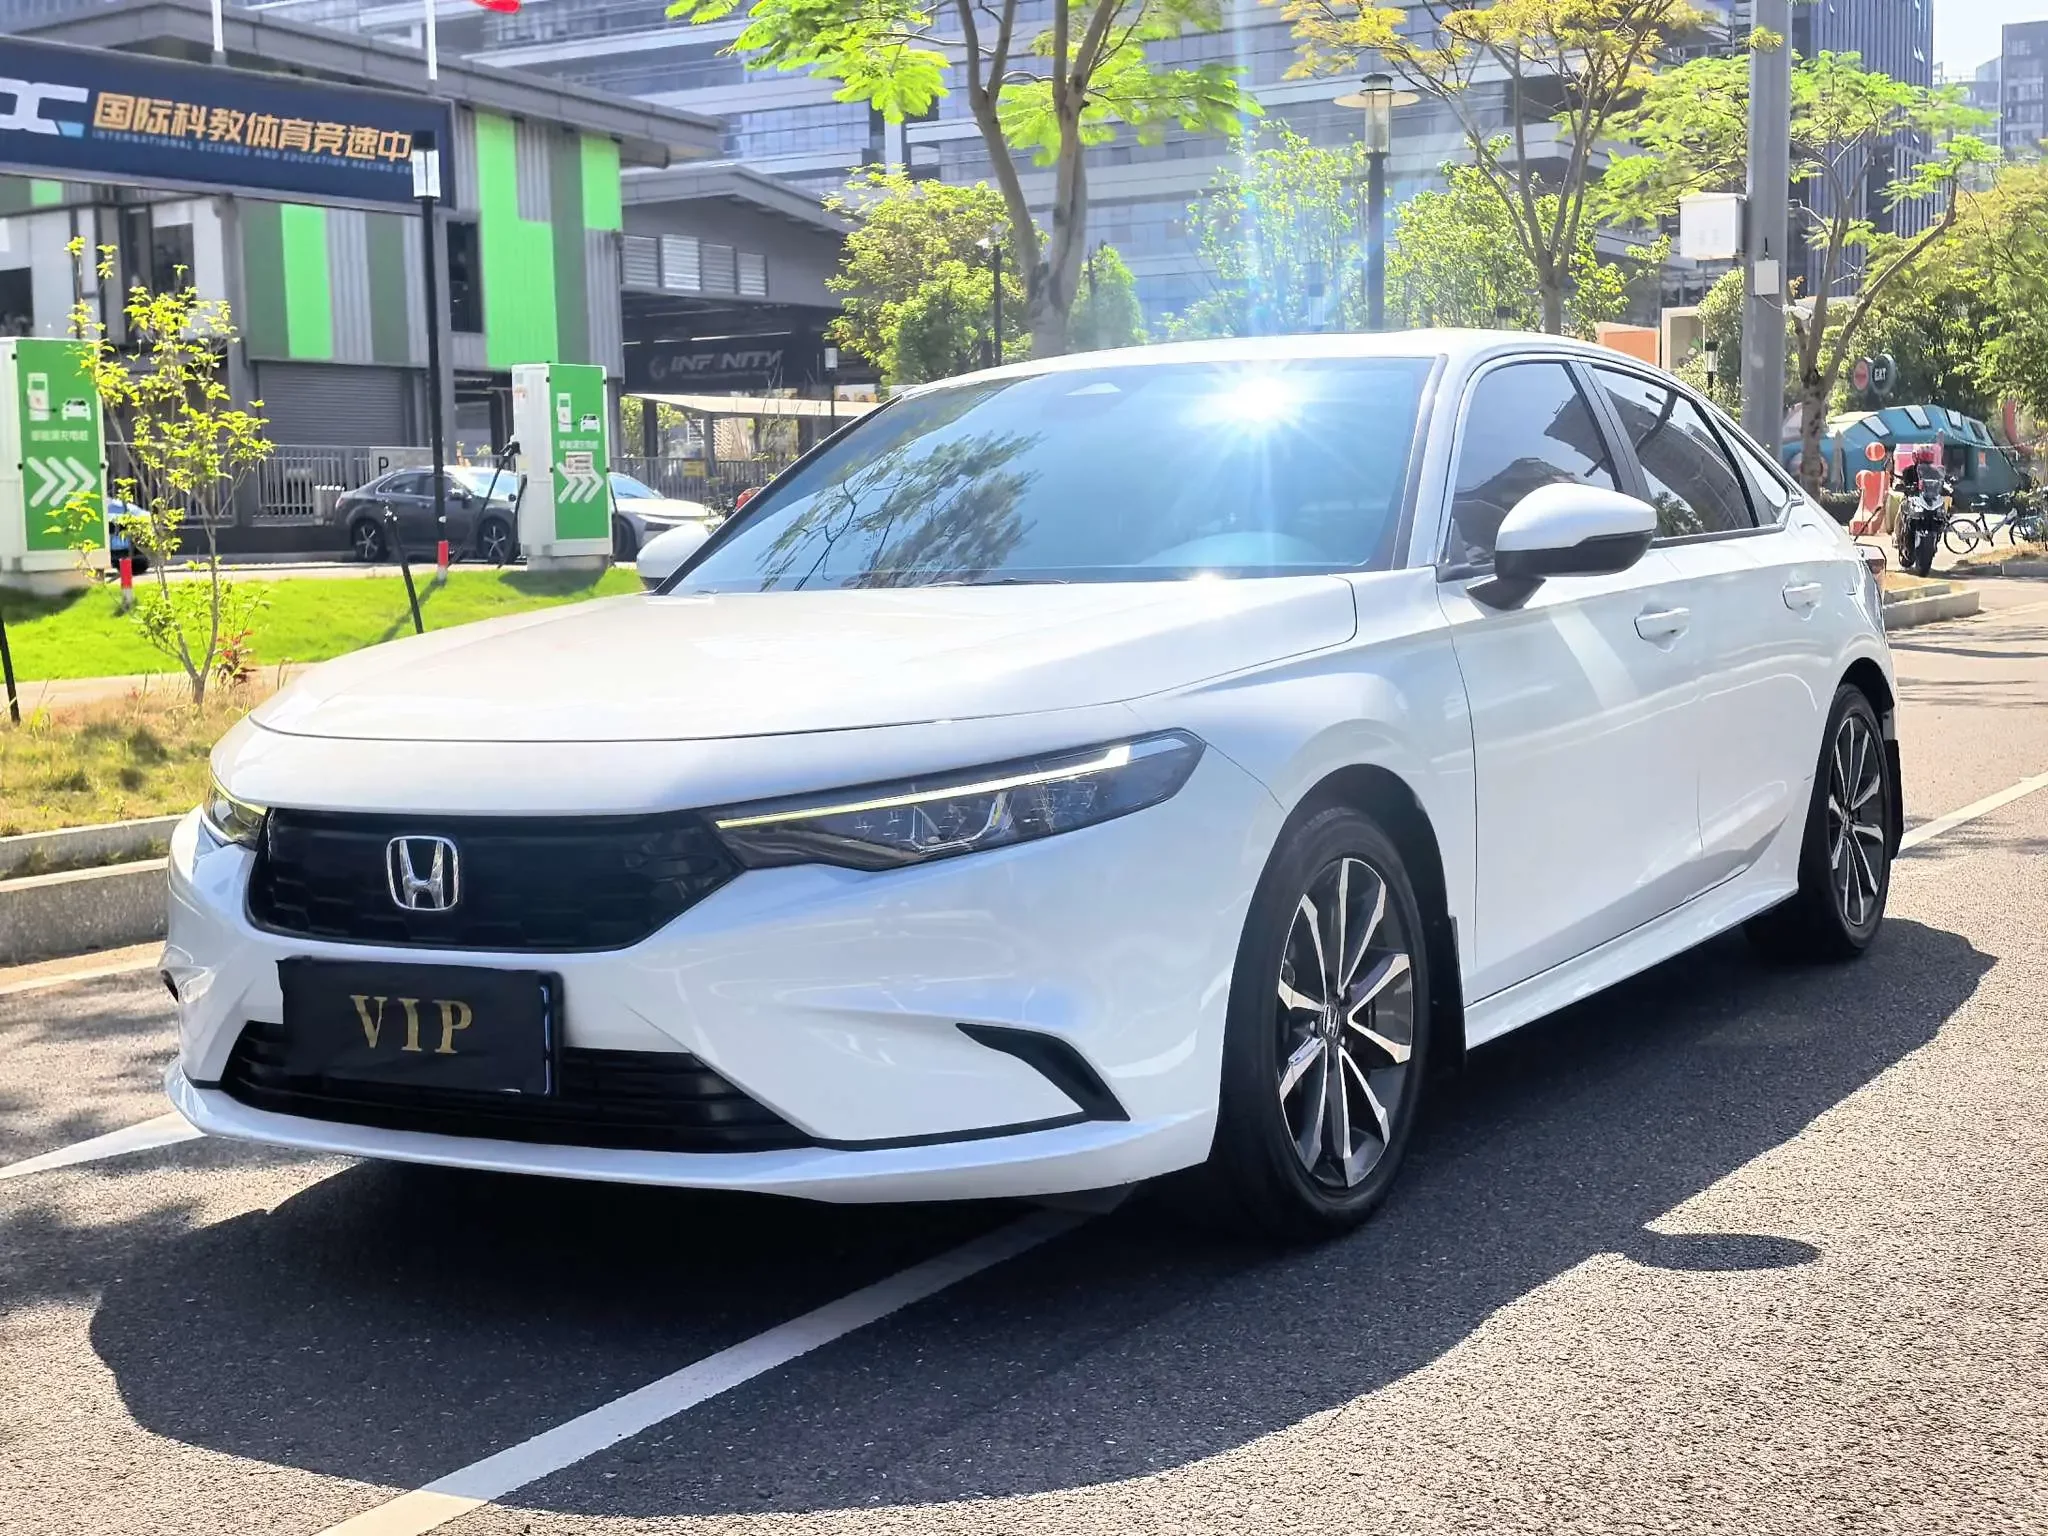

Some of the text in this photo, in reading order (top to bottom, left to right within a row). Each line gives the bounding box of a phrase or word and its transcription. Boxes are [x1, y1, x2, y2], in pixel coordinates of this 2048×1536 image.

[92, 129, 193, 151] INTERNATIONAL
[198, 142, 250, 156] SCIENCE
[254, 149, 280, 161] AND
[282, 152, 348, 168] EDUCATION
[351, 161, 394, 174] RACING
[93, 92, 413, 162] 国际科教体育竞速中
[350, 994, 473, 1054] VIP
